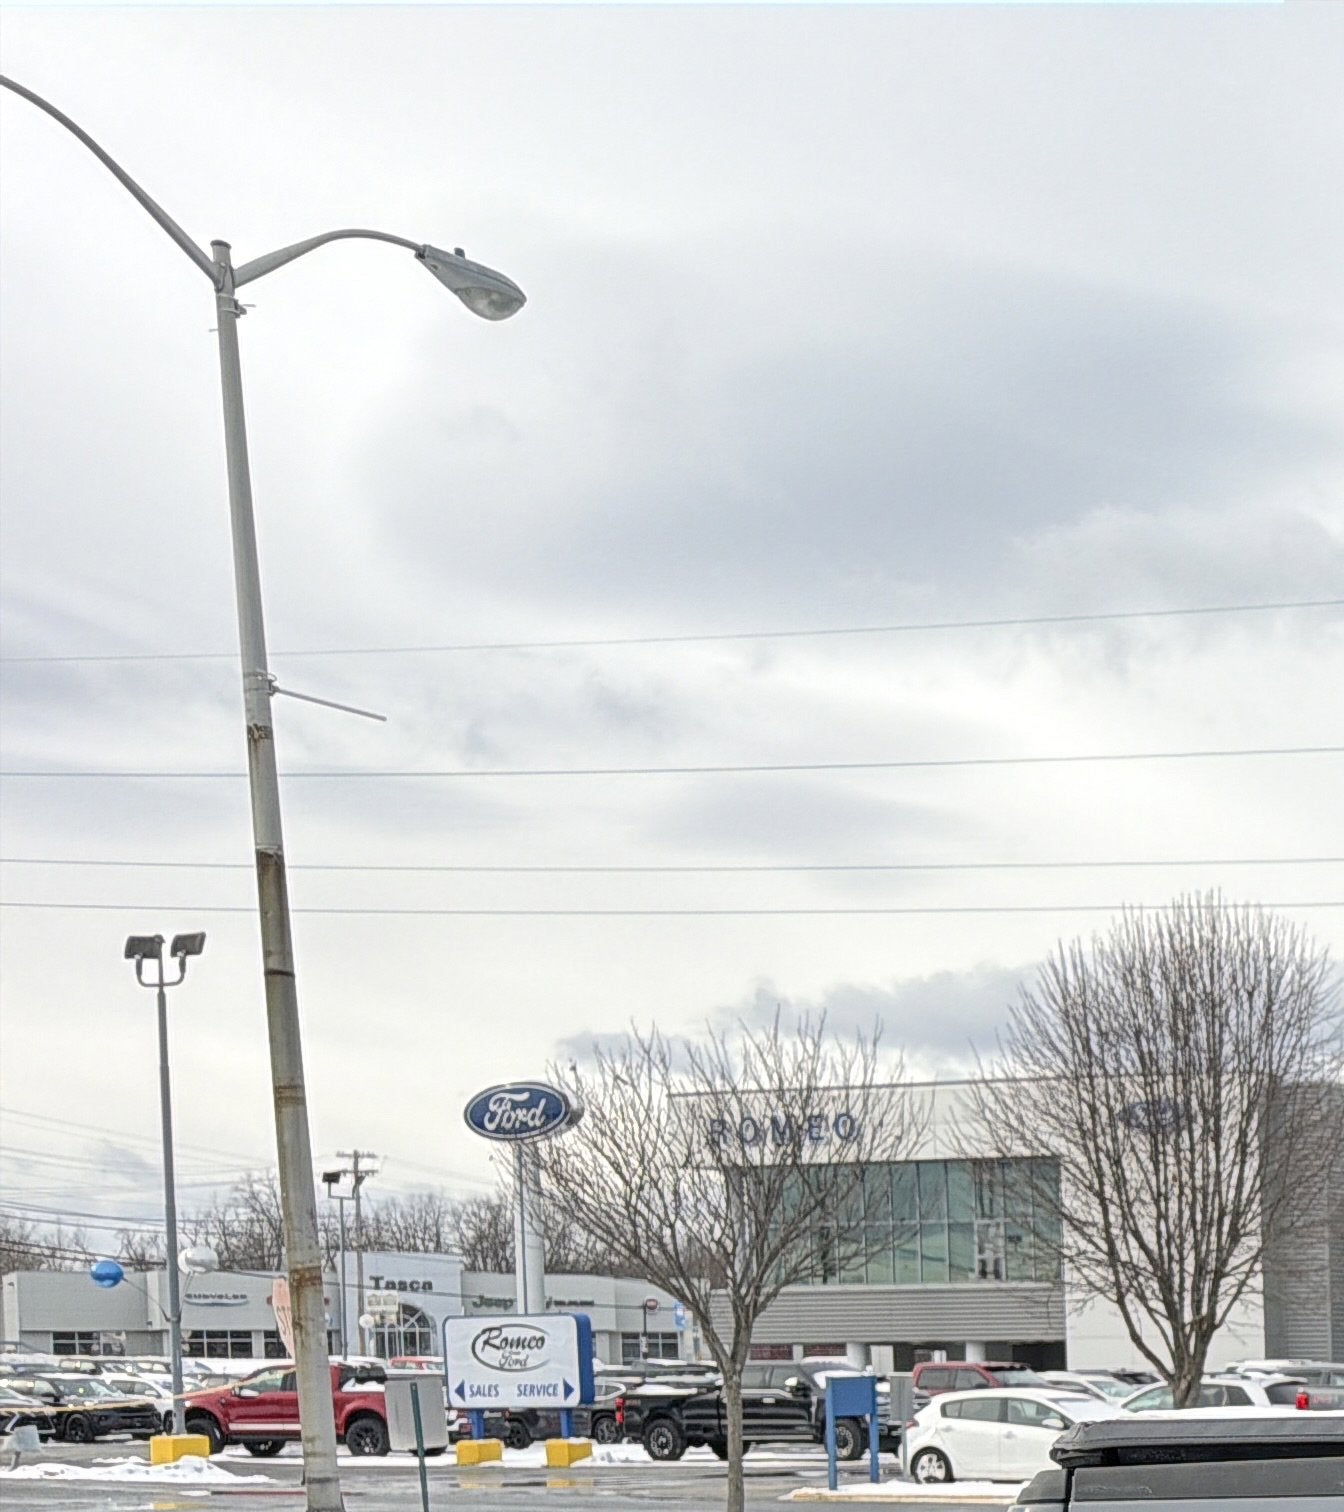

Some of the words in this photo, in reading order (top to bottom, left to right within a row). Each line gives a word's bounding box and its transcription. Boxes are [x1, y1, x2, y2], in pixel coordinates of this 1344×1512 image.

[484, 1091, 547, 1131] Ford
[369, 1275, 433, 1292] Tasca
[498, 1350, 529, 1368] Ford
[469, 1384, 500, 1398] SALES
[516, 1383, 559, 1398] SERVICE
